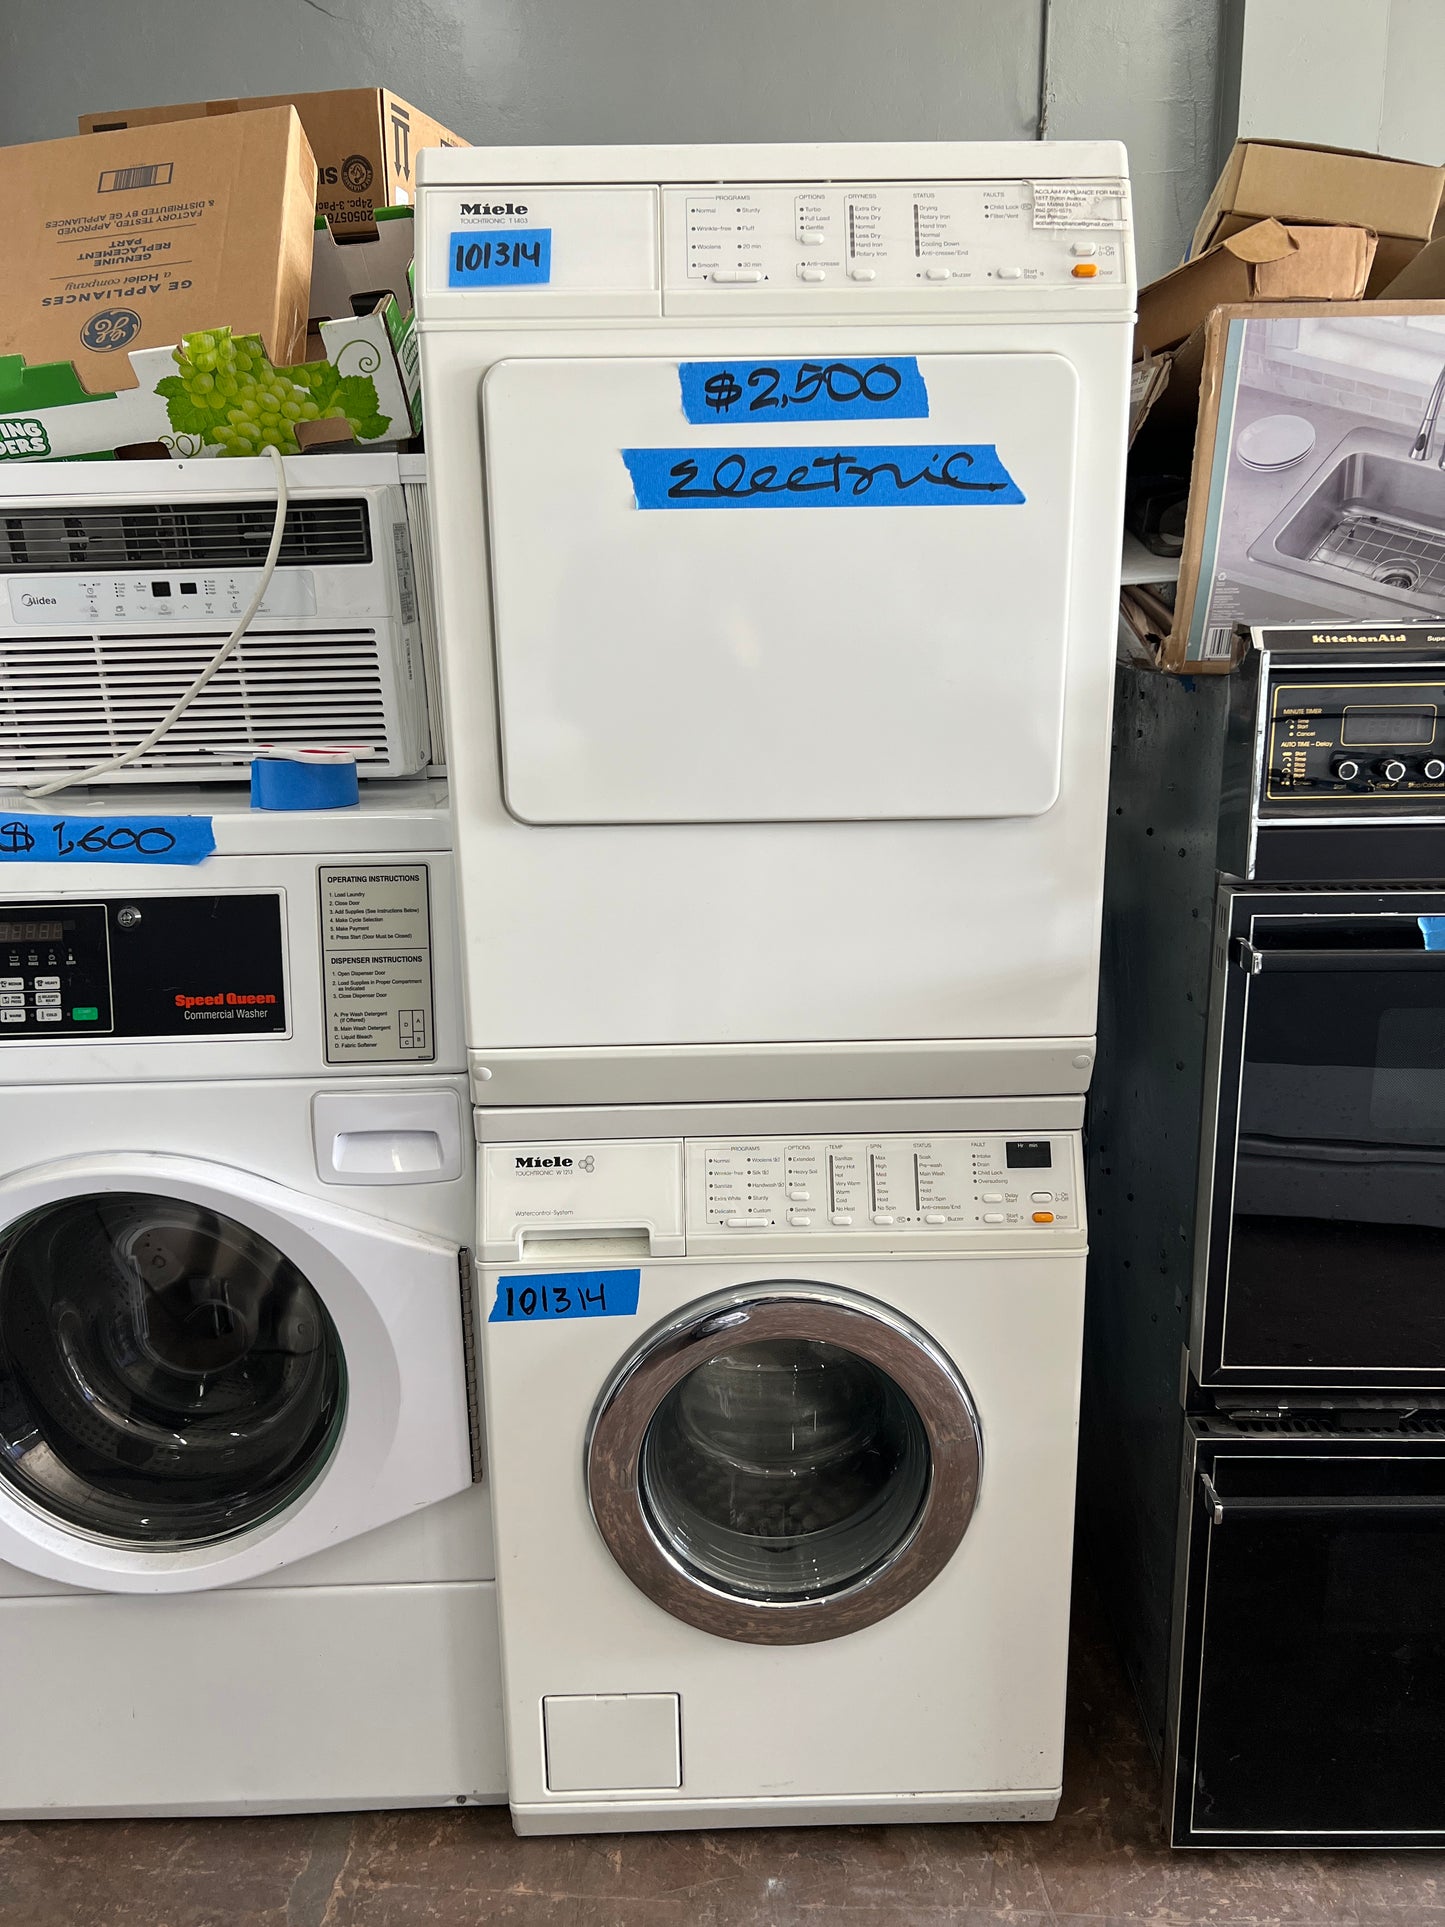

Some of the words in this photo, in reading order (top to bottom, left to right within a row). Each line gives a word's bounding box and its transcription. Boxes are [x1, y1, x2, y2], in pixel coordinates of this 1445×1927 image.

[317, 166, 338, 185] SI
[141, 201, 205, 216] DISTRIBUTED
[347, 197, 373, 208] 24pc.
[126, 209, 139, 219] BY
[460, 203, 528, 215] Miele
[45, 215, 106, 229] APPLIANCES
[114, 217, 154, 228] TESTED,
[156, 210, 203, 223] FACTORY
[322, 210, 374, 224] 2050576
[57, 222, 111, 235] APPROVED
[109, 238, 142, 249] PART
[77, 241, 172, 261] REPLACEMENT
[456, 241, 541, 272] 101314
[94, 253, 152, 267] GENUINE
[123, 273, 159, 285] Haier
[164, 271, 172, 279] a
[65, 278, 121, 291] company
[168, 279, 193, 291] GE
[41, 286, 161, 307] APPLIANCES
[21, 593, 57, 607] Midea
[1312, 633, 1407, 643] KitchenAid
[1315, 740, 1334, 748] Delay
[368, 874, 420, 882] INSTRUCTIONS
[372, 955, 423, 963] INSTRUCTIONS
[174, 993, 224, 1009] Speed
[226, 992, 276, 1005] Queen
[184, 1009, 234, 1020] Commercial
[236, 1009, 268, 1019] Washer
[515, 1156, 573, 1168] Miele
